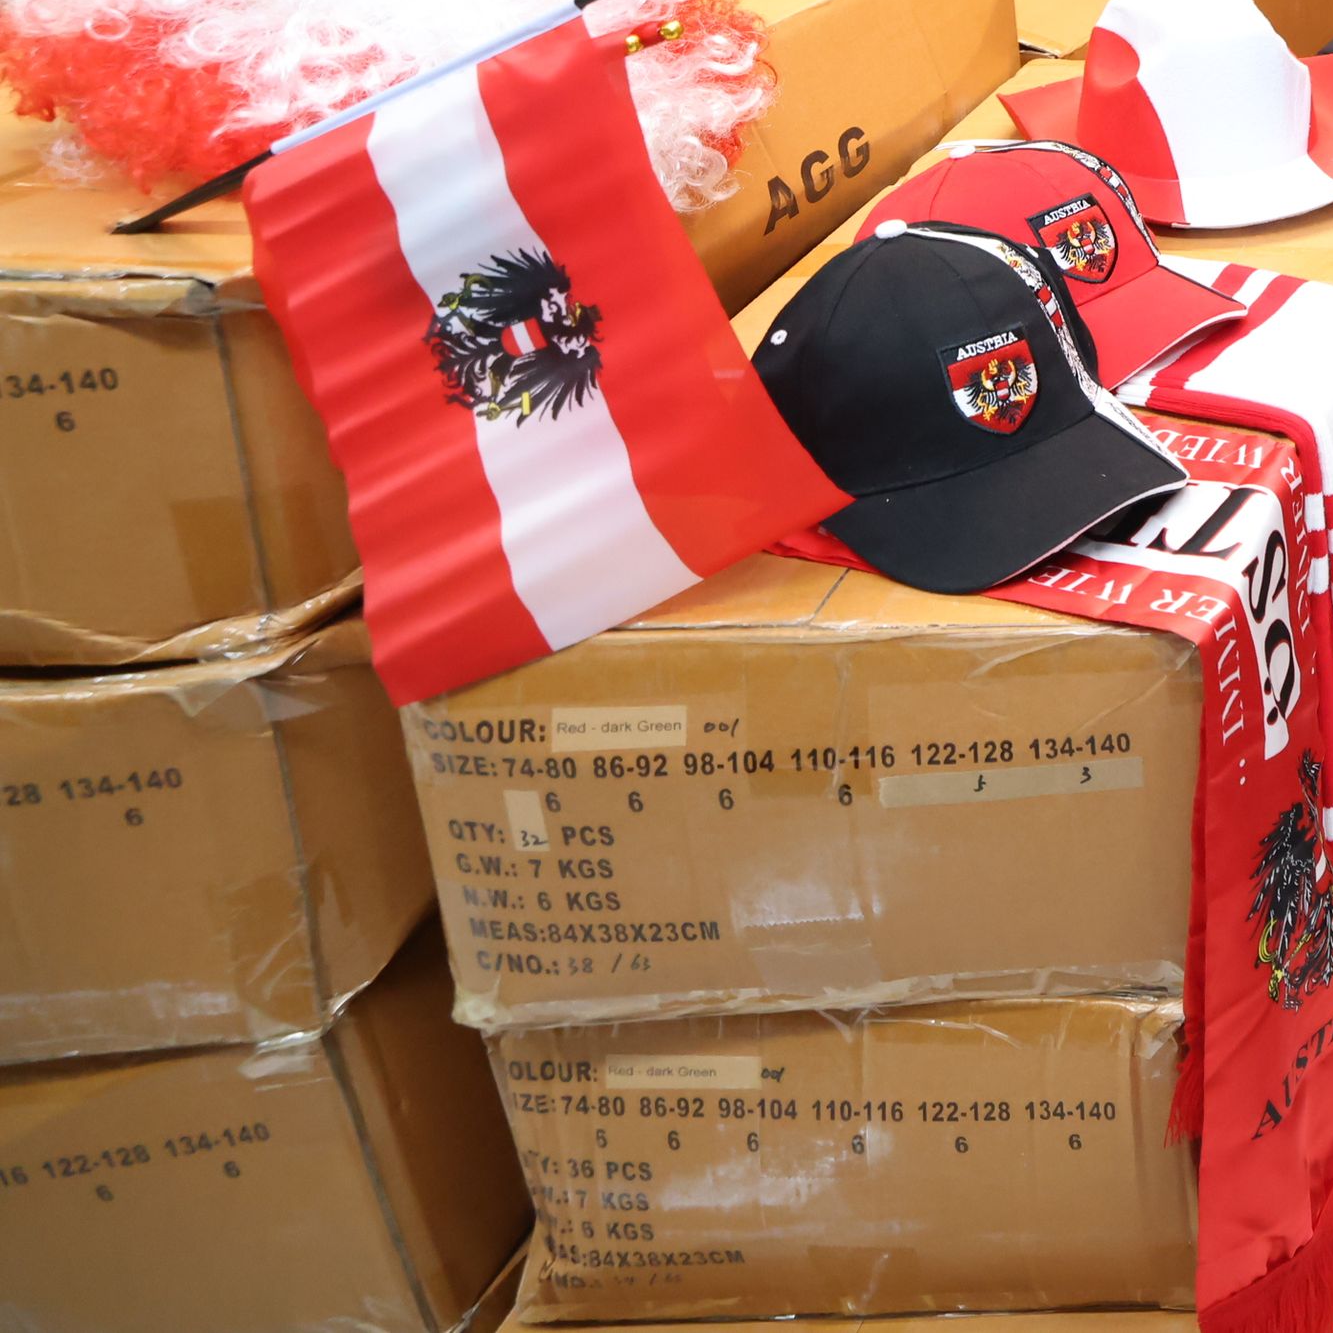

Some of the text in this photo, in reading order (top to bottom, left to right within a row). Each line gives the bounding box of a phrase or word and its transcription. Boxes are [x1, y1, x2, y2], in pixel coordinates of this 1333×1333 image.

[760, 127, 874, 239] AGG
[1044, 200, 1091, 225] AUSTRIA
[956, 332, 1018, 361] AUSTRIA
[422, 718, 681, 745] COLOUR: Red dark Green
[593, 733, 1130, 778] 86-92 98-104 110-116 122-128 134-140
[58, 768, 182, 800] 134-140
[918, 1101, 1115, 1122] 122-128 134-140
[41, 1123, 270, 1178] 122-128 134-140
